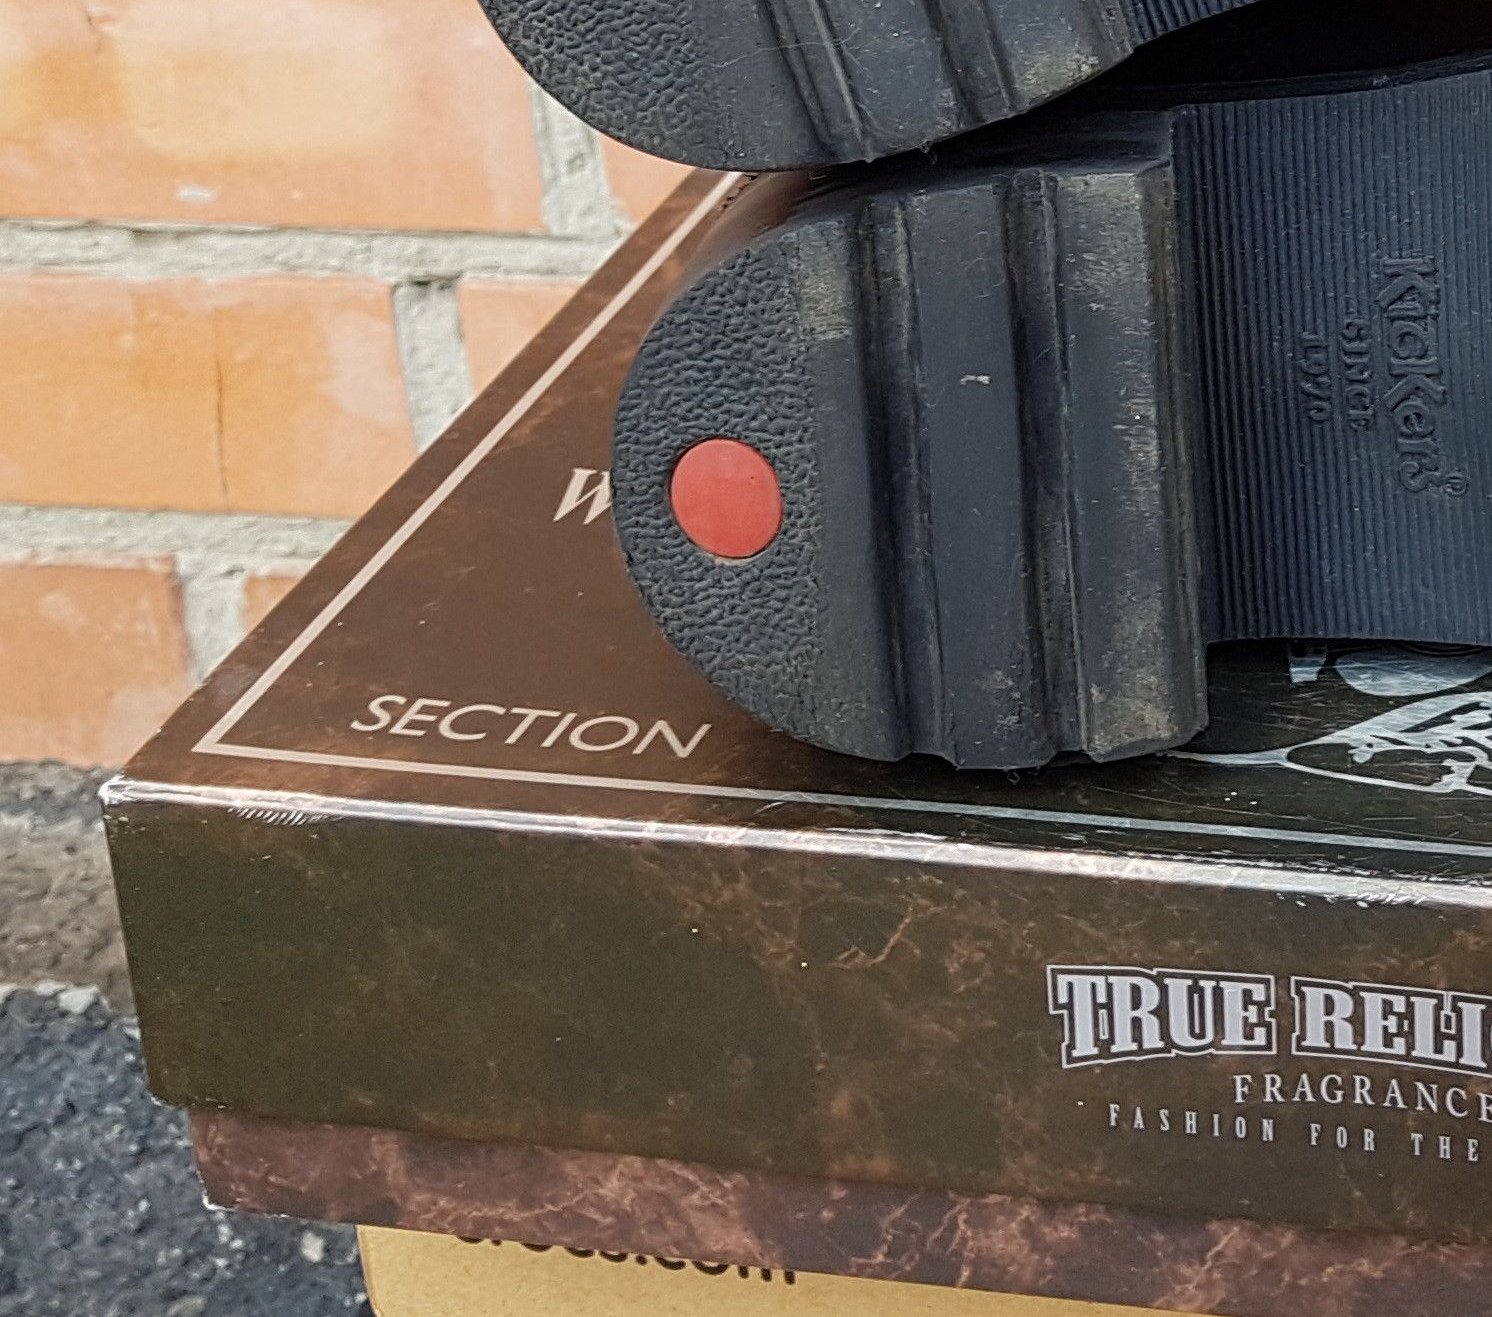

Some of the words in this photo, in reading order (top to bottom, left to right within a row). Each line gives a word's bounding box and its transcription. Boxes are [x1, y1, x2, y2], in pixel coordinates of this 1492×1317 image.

[351, 694, 712, 760] SECTION
[1048, 965, 1277, 1068] TRUE
[1109, 1104, 1275, 1143] FASHION
[1310, 1124, 1376, 1152] FOR
[1411, 1133, 1479, 1163] THE
